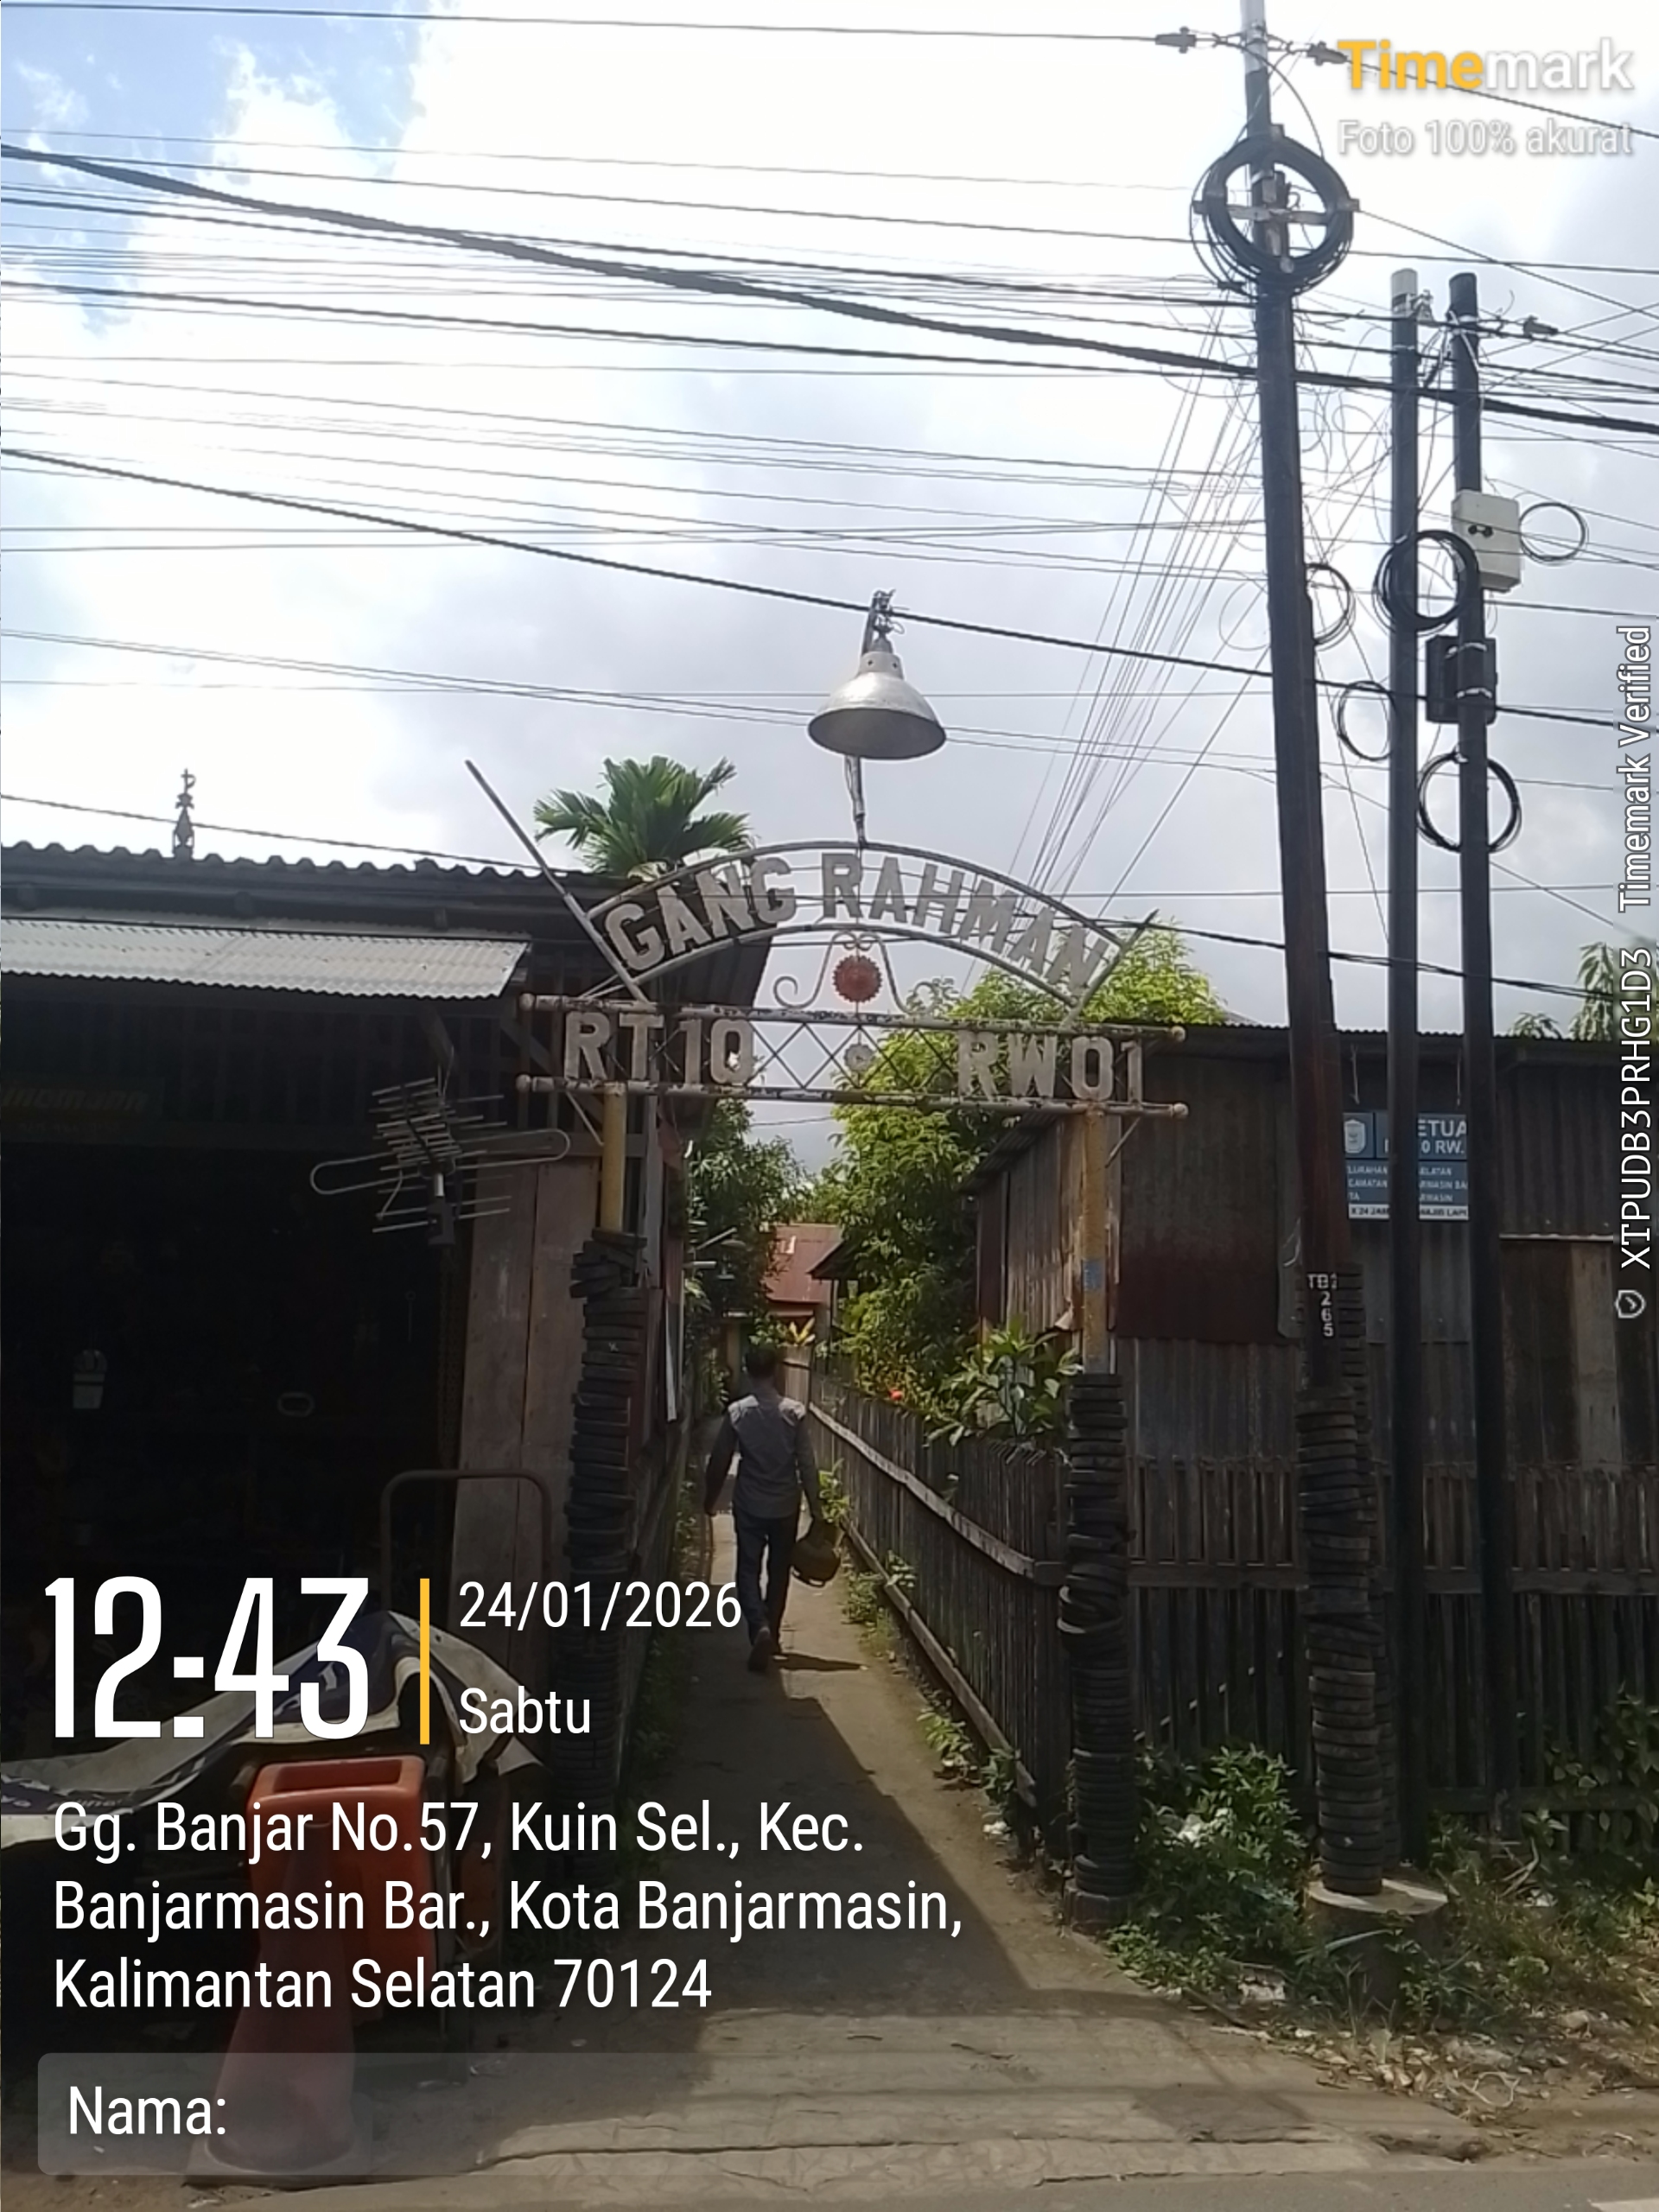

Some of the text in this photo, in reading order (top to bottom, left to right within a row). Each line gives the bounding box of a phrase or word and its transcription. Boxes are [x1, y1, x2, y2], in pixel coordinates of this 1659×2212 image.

[604, 851, 1109, 992] GANG RAHMAN
[1418, 1119, 1467, 1138] ETUA
